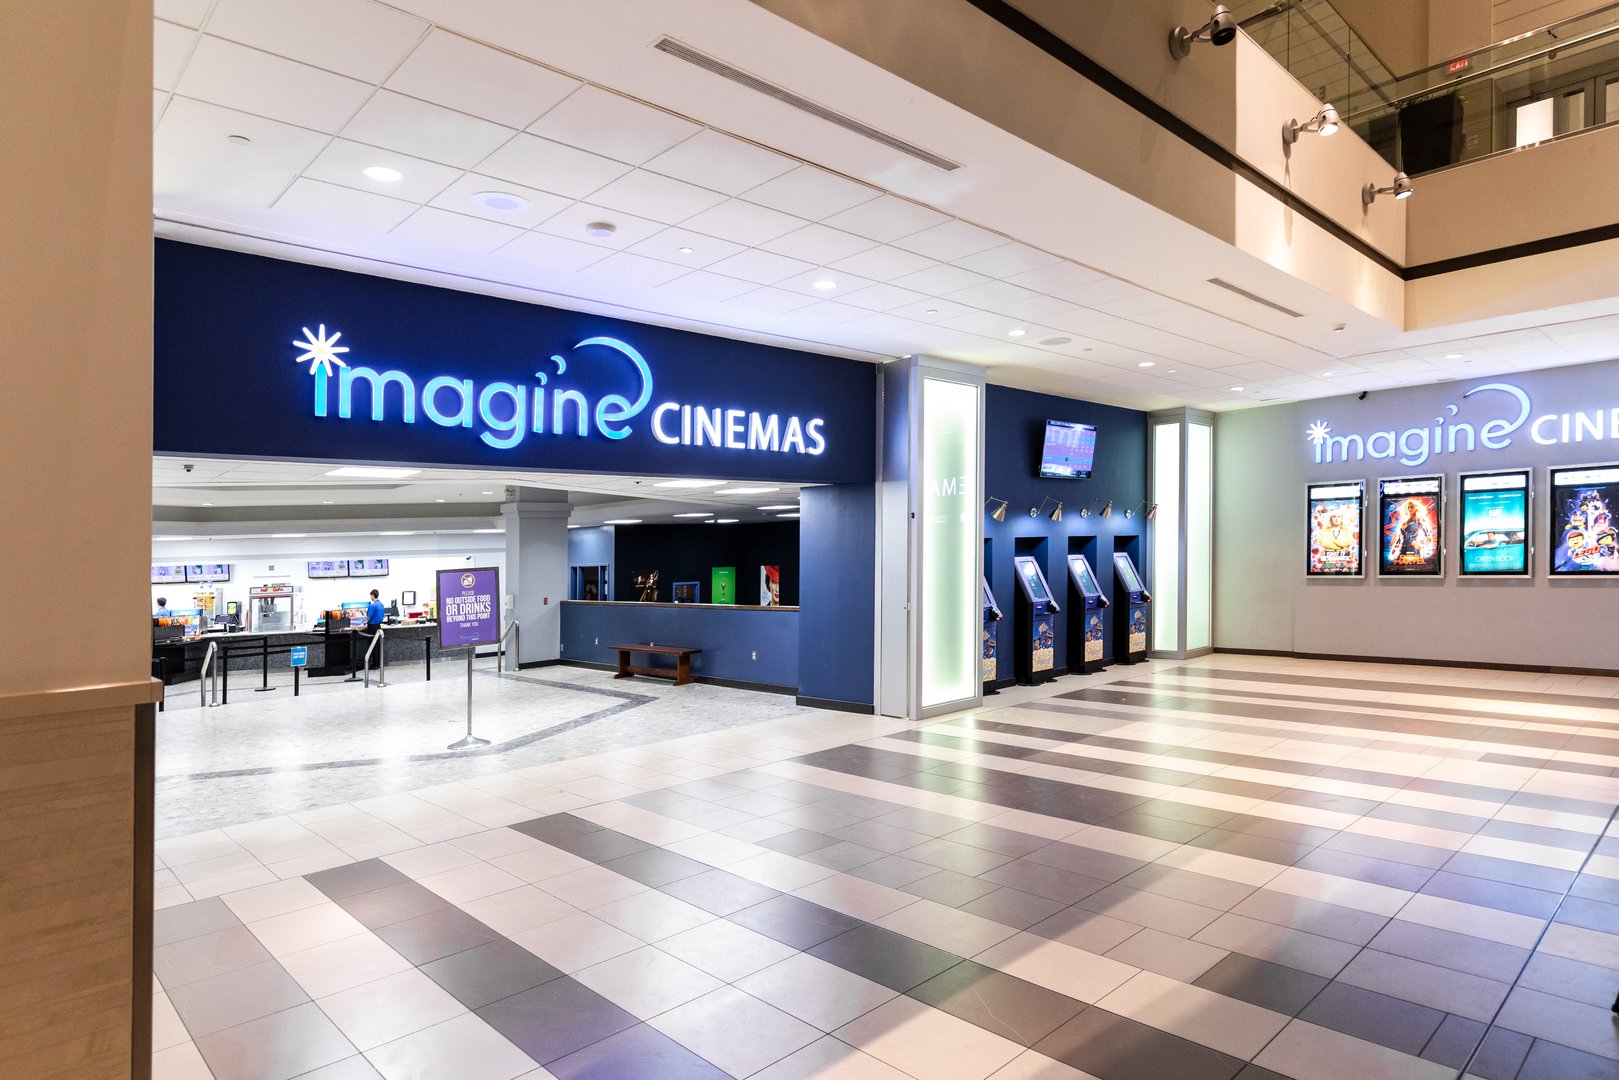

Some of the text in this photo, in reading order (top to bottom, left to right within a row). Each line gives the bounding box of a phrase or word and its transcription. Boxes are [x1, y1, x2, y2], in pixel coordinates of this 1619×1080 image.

[293, 323, 825, 456] imagine CINEMAS
[1306, 383, 1530, 466] imagine
[446, 602, 491, 615] OR DRINKS
[455, 596, 476, 604] OUTSIDE
